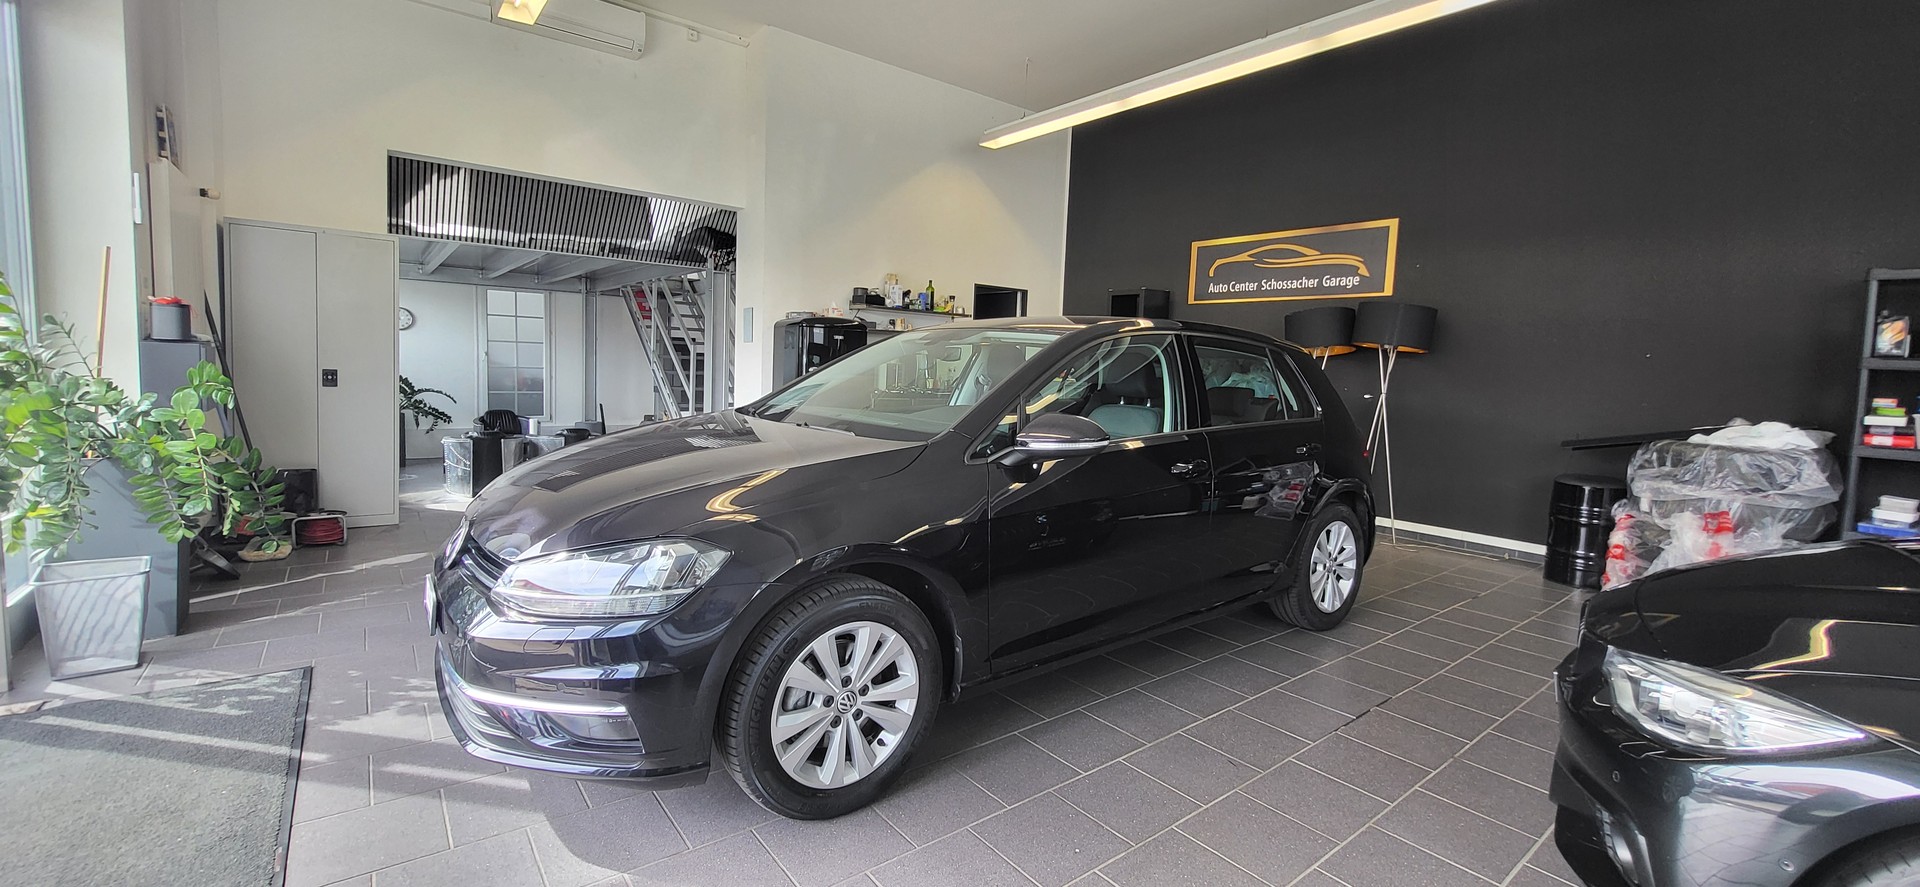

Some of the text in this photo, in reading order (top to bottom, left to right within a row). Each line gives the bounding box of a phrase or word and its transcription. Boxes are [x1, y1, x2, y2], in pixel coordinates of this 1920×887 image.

[1208, 275, 1360, 293] Auto Center Schossacher Garage
